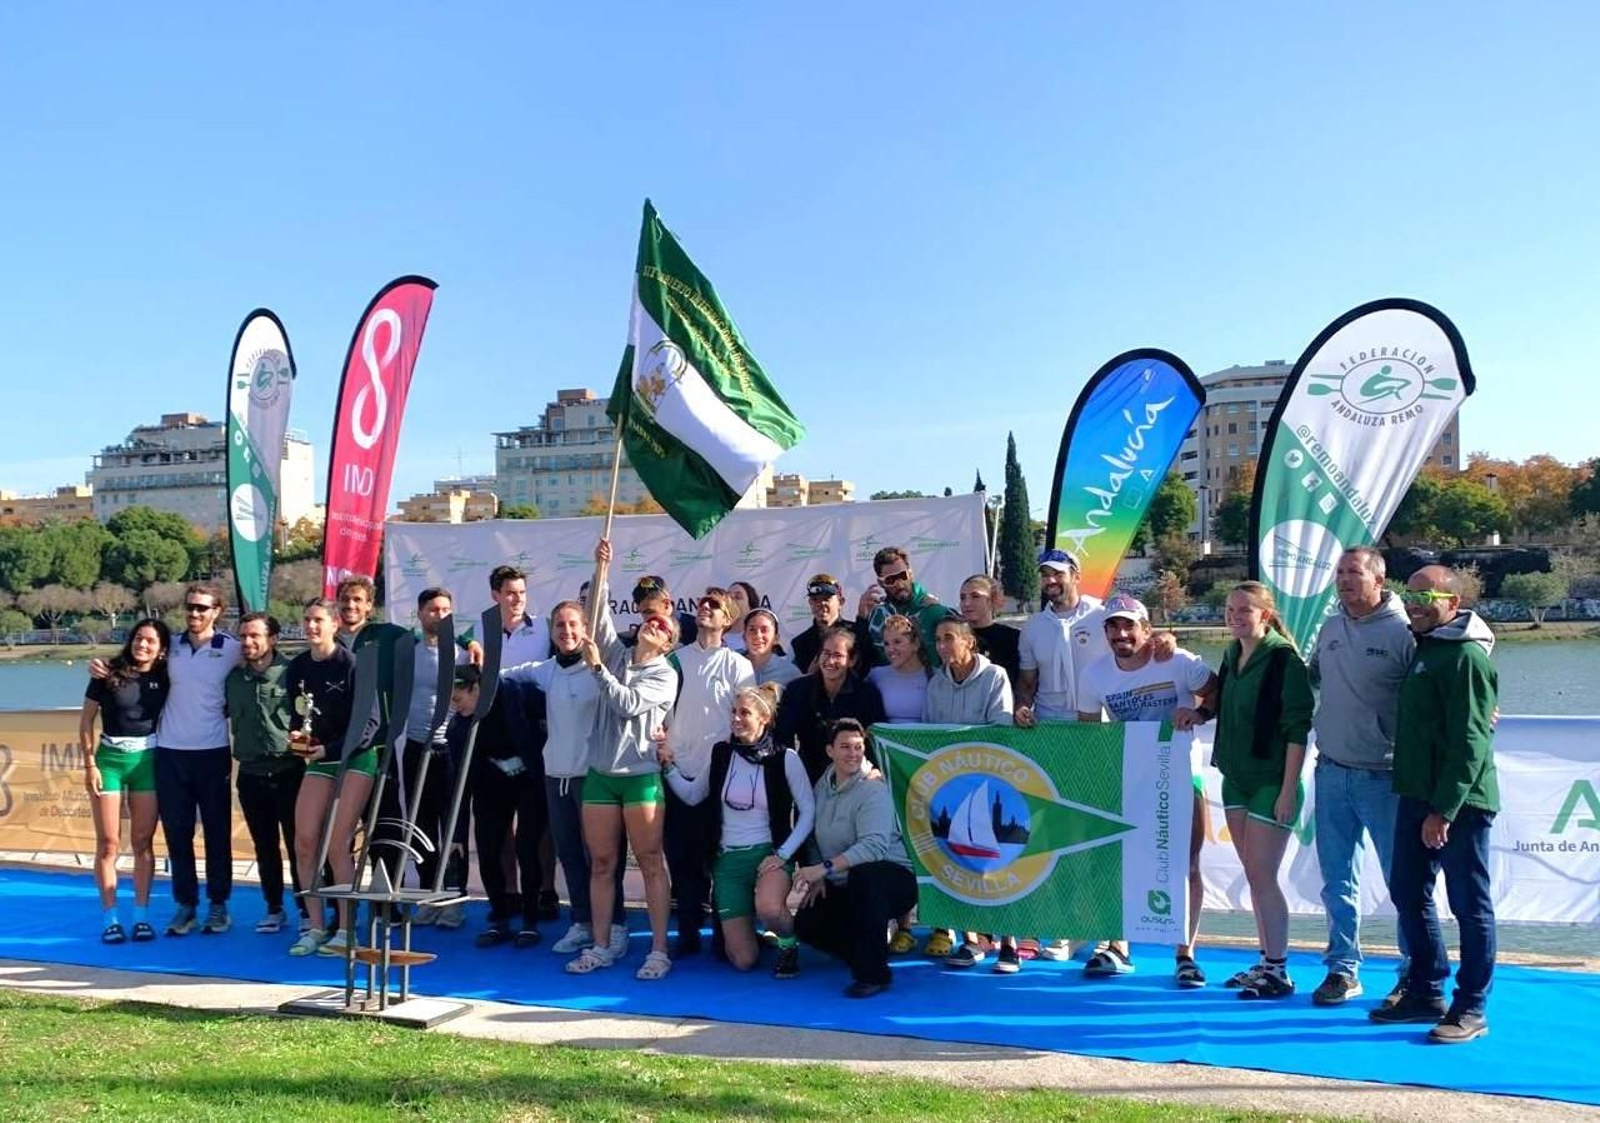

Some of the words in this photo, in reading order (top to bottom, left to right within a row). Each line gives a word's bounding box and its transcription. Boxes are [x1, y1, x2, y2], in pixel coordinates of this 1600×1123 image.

[1340, 346, 1436, 375] FEDERACION
[1331, 400, 1386, 427] ANDALUZA
[1391, 404, 1424, 425] REMO
[1058, 396, 1176, 558] Andalucía
[911, 770, 938, 820] CLUB
[1512, 840, 1554, 852] Junta
[1558, 840, 1576, 852] de
[940, 863, 1020, 892] SEVILLA
